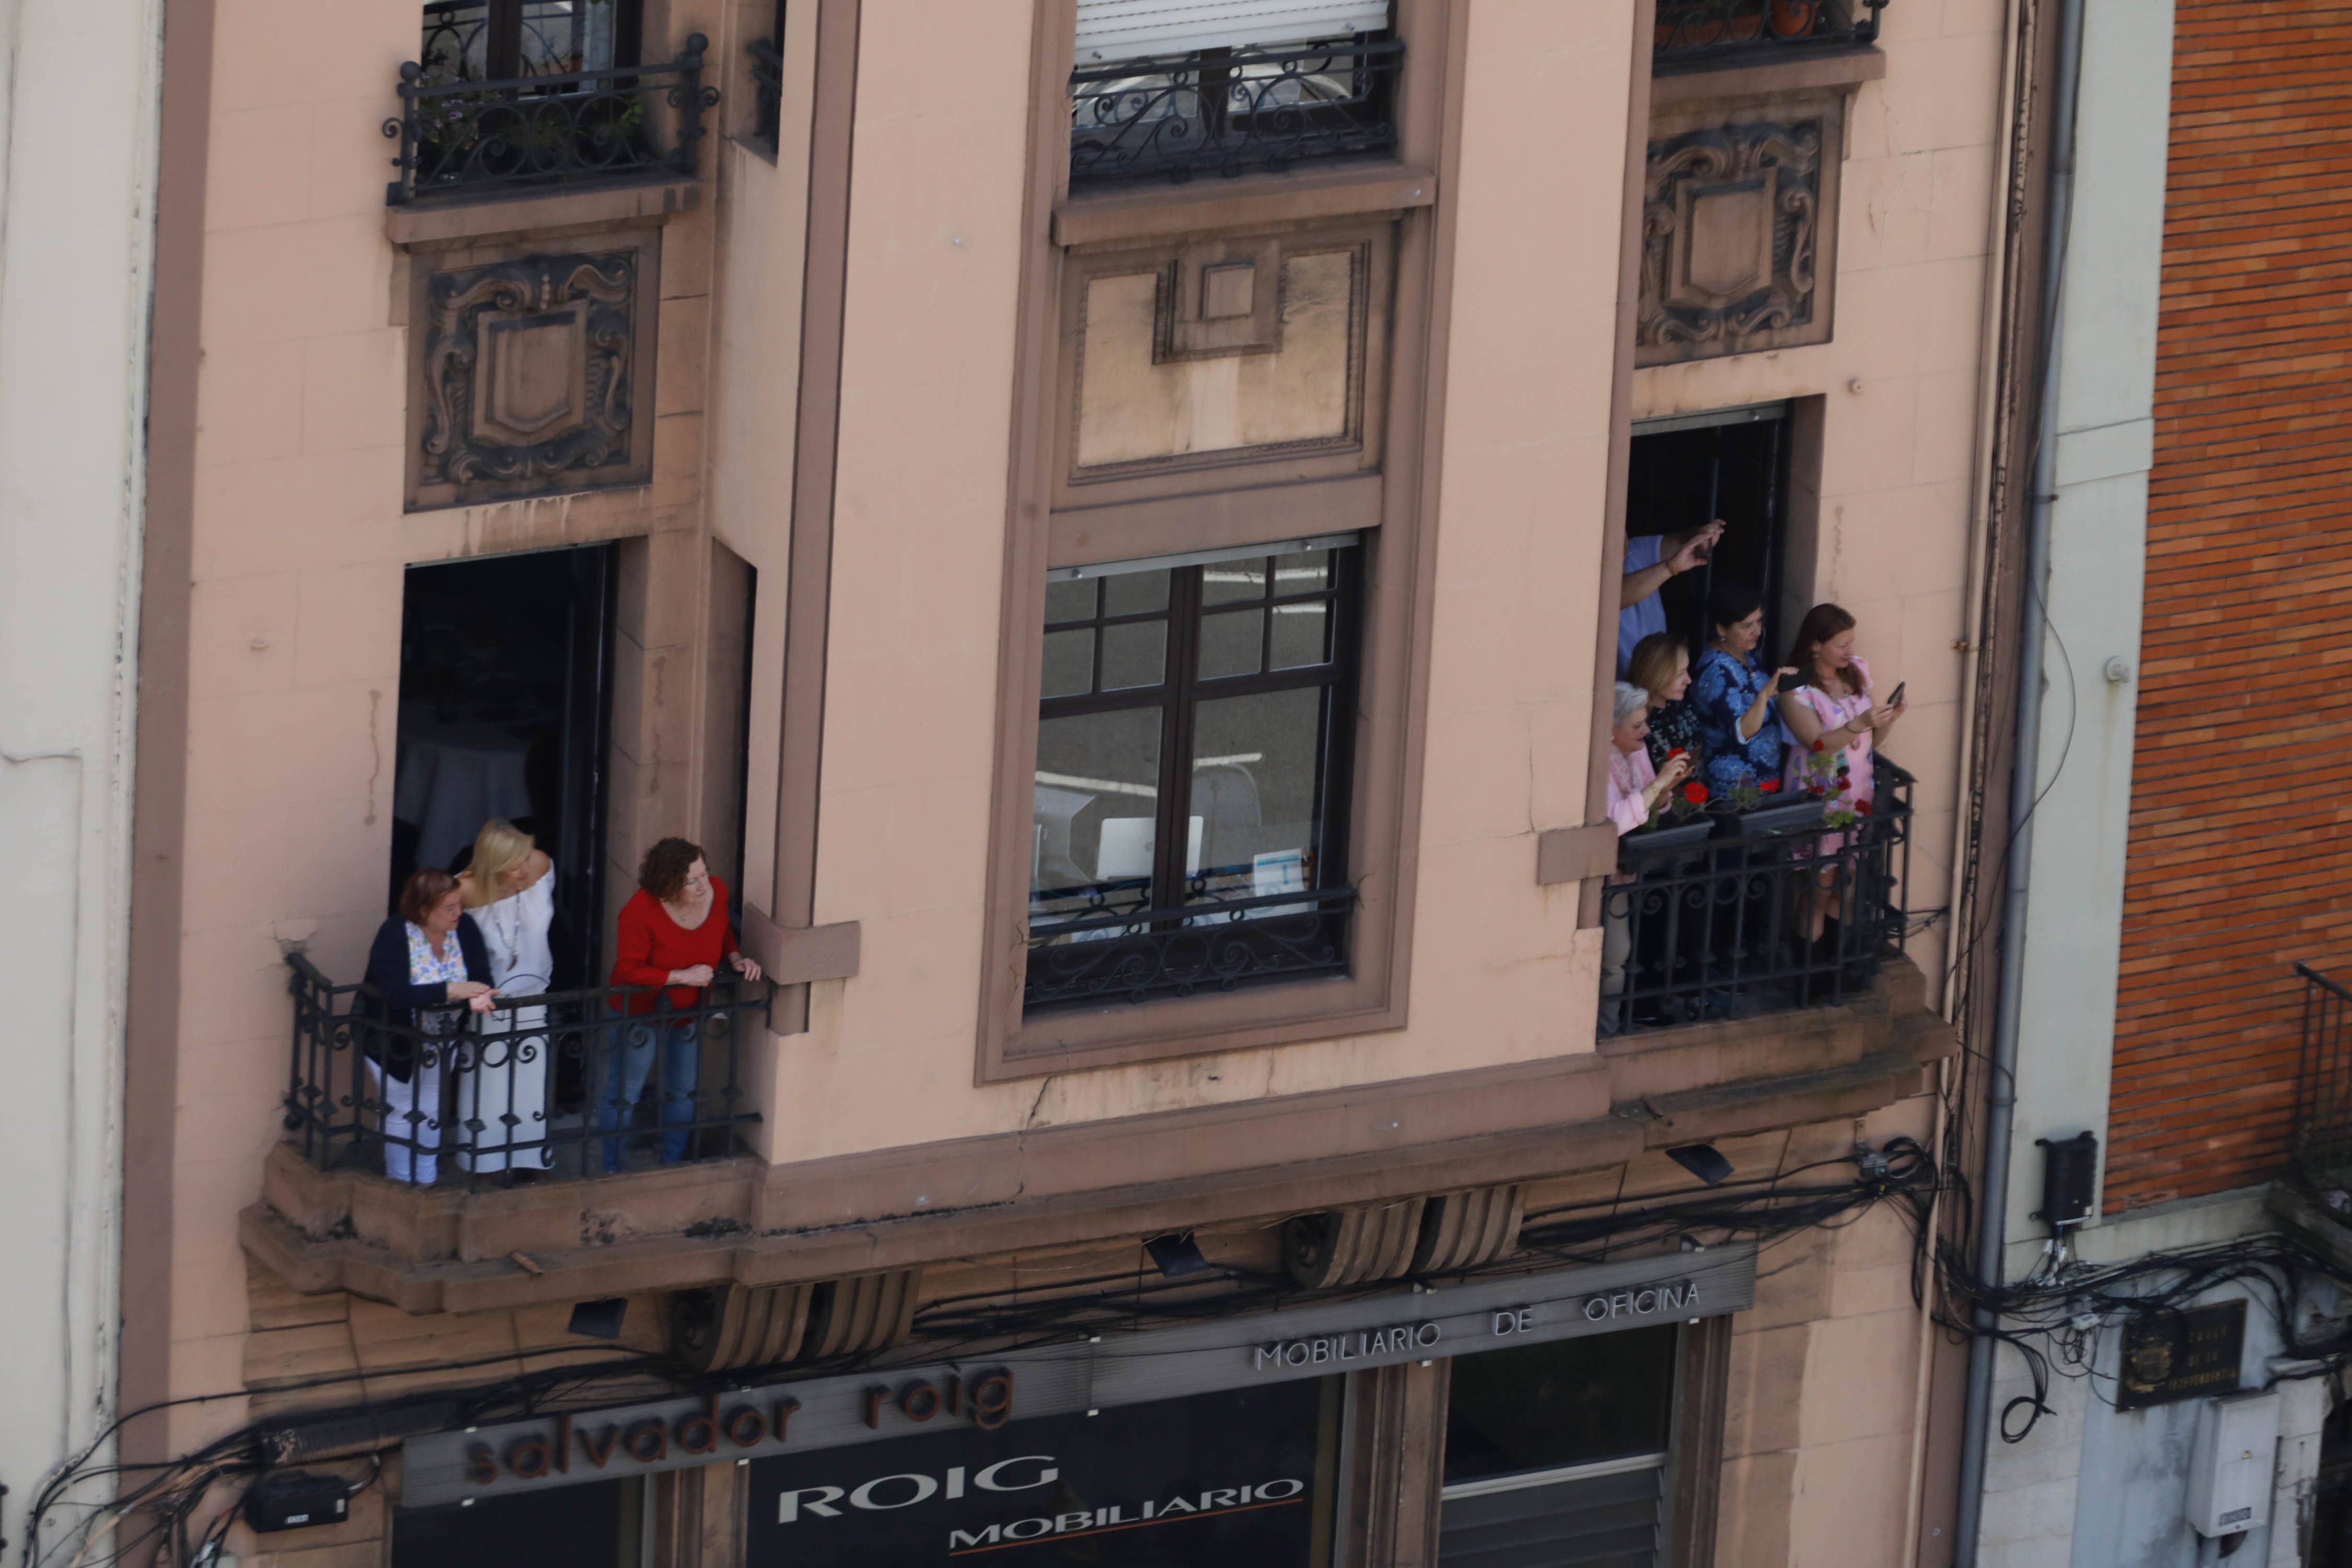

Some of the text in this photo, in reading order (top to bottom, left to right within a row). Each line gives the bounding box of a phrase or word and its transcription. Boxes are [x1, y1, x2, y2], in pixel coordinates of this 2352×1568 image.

[1258, 1283, 1700, 1370] MOBILIARIO DE OFICINA
[470, 1363, 1014, 1484] salvador roig
[778, 1456, 1058, 1524] ROIG
[949, 1479, 1304, 1549] MOBILIARIO
